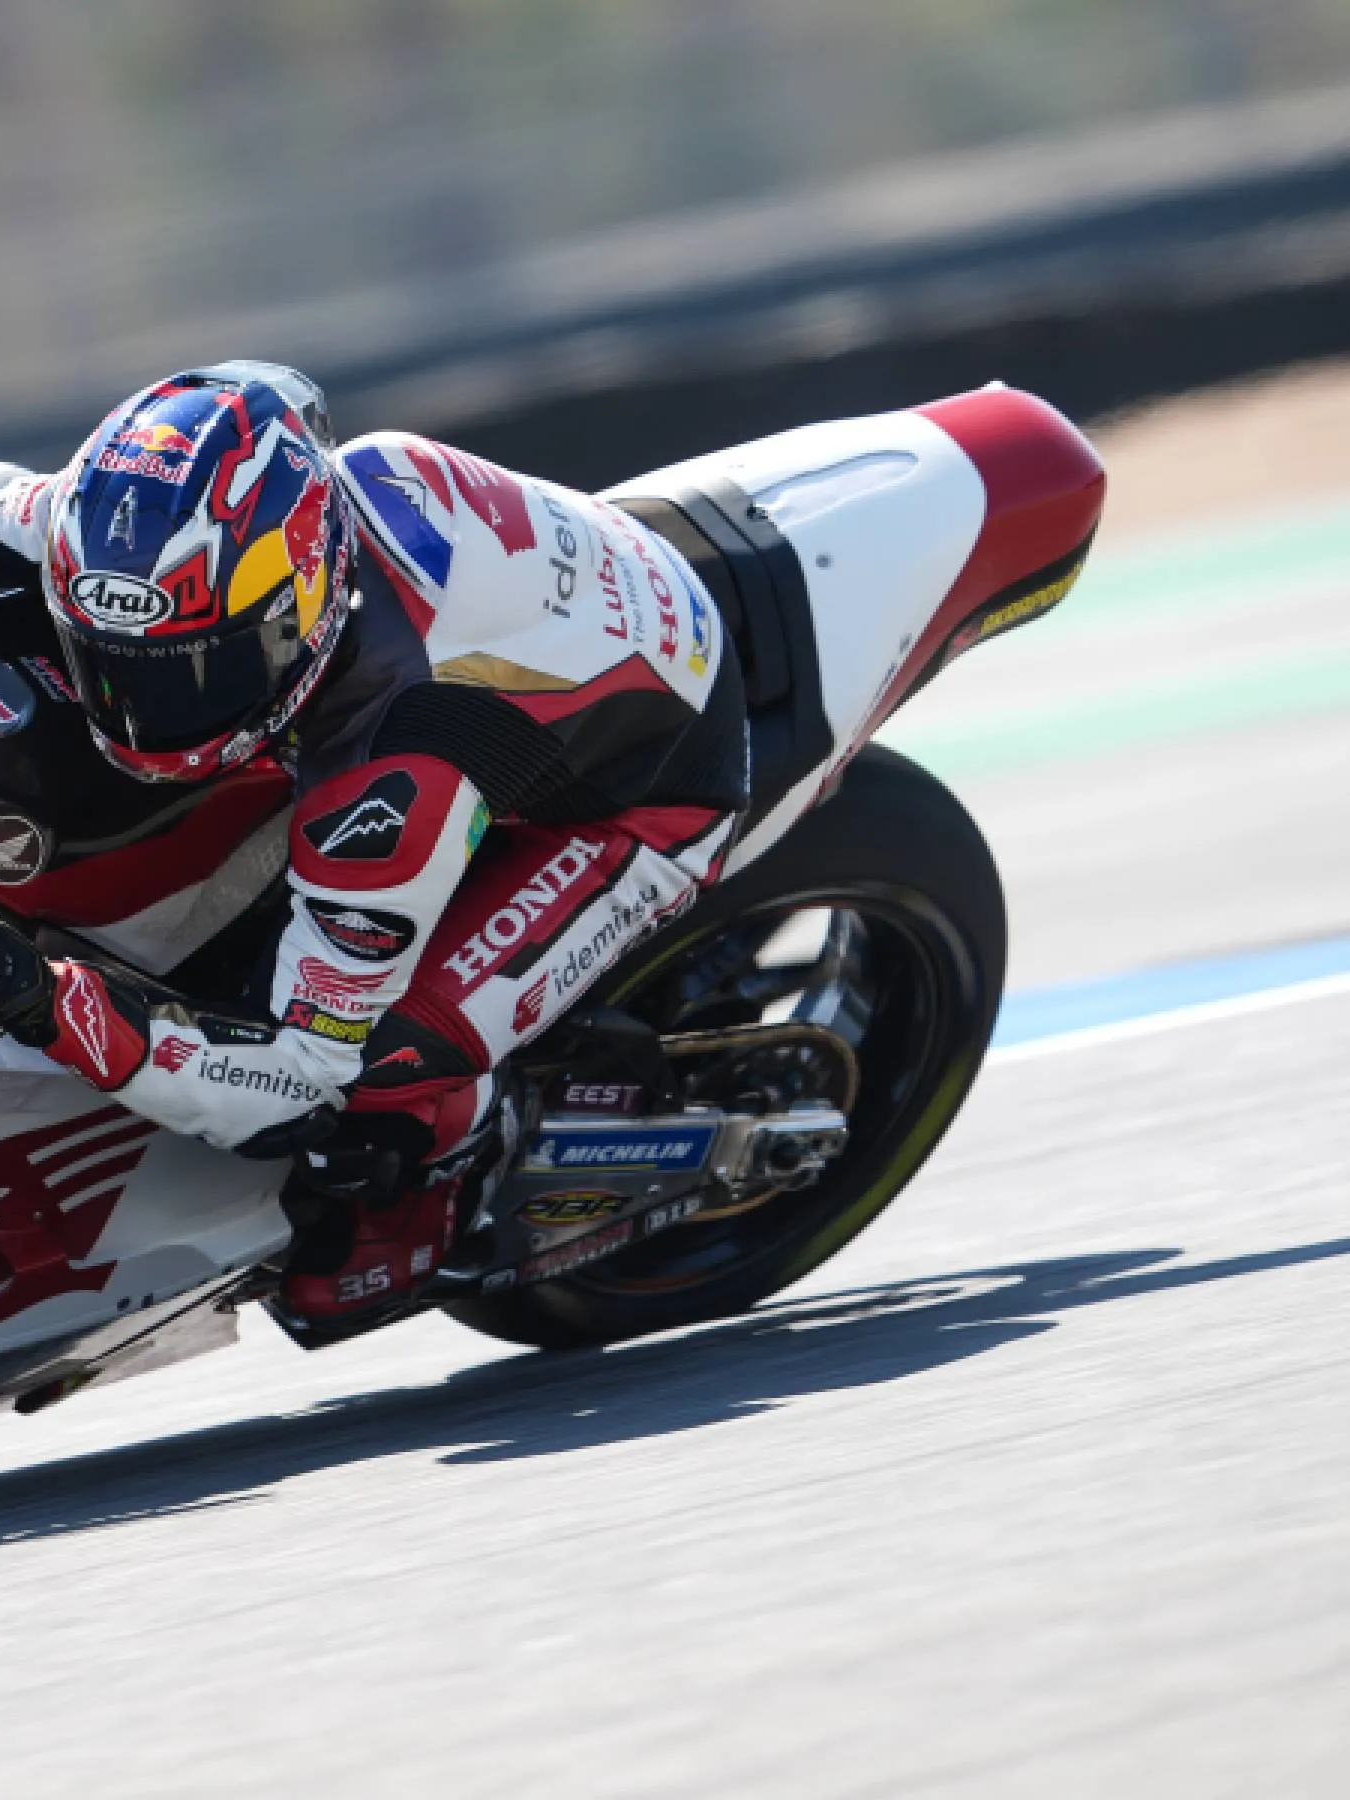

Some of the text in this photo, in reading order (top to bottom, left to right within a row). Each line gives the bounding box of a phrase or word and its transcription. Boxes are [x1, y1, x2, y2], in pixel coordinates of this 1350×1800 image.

[78, 578, 153, 608] Arai
[551, 884, 659, 996] idemitsu
[199, 1051, 321, 1101] idemitsu
[560, 1141, 694, 1166] MICHELIN
[338, 1264, 391, 1302] 35
